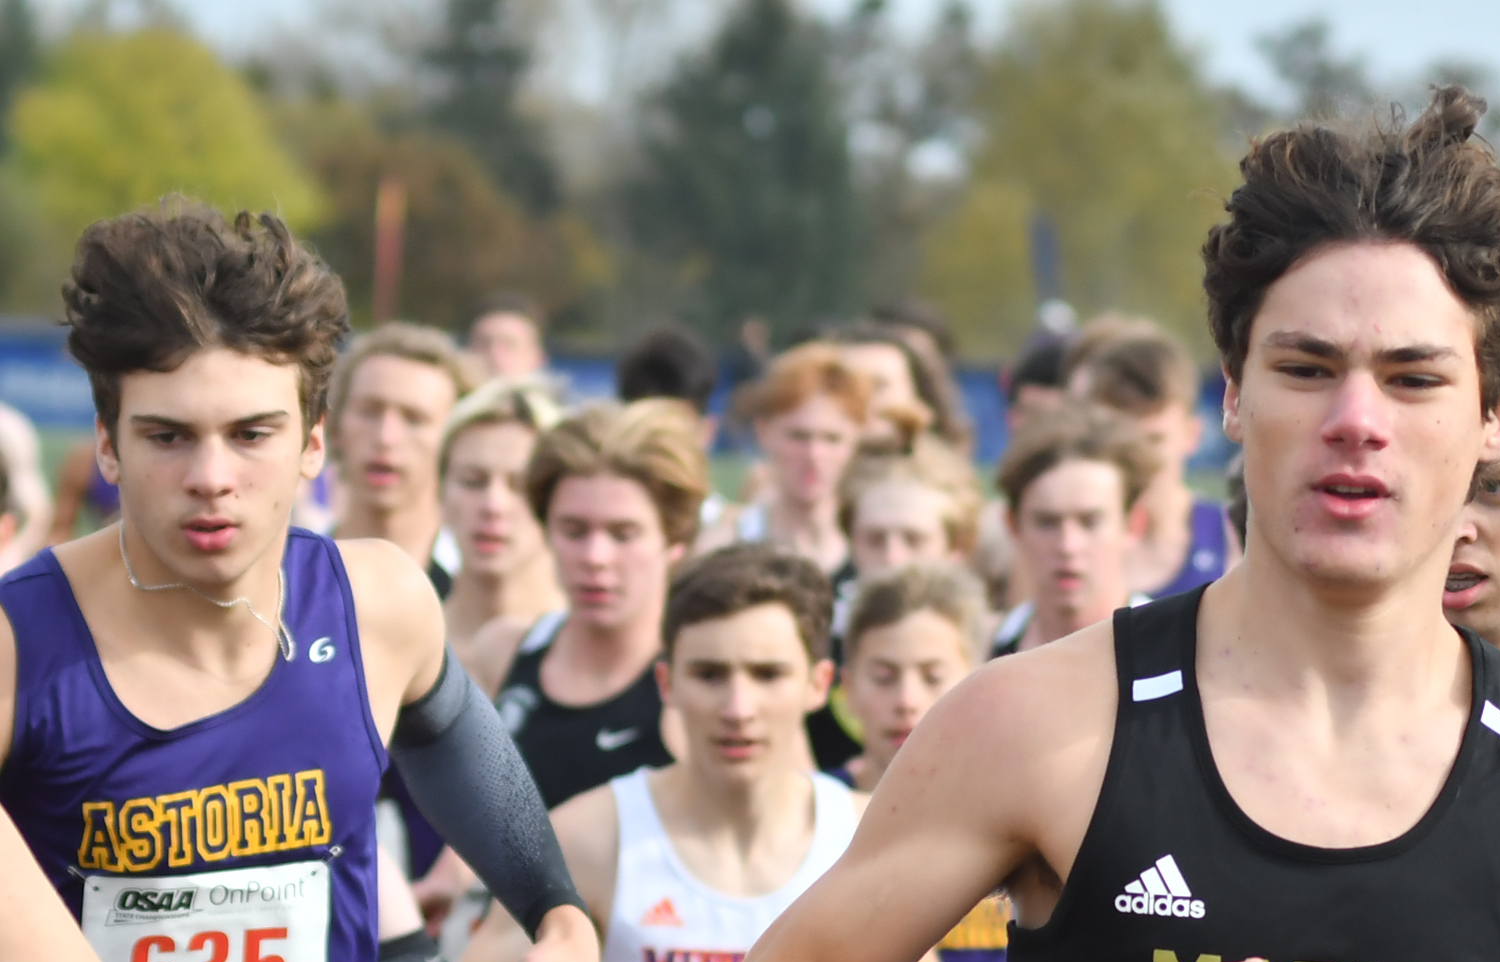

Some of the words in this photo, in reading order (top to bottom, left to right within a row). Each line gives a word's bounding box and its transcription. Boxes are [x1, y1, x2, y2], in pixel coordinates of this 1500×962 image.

[77, 769, 331, 872] ASTORIA
[116, 889, 195, 912] OSAA
[209, 877, 304, 906] OnPoint
[1114, 892, 1206, 919] adidas
